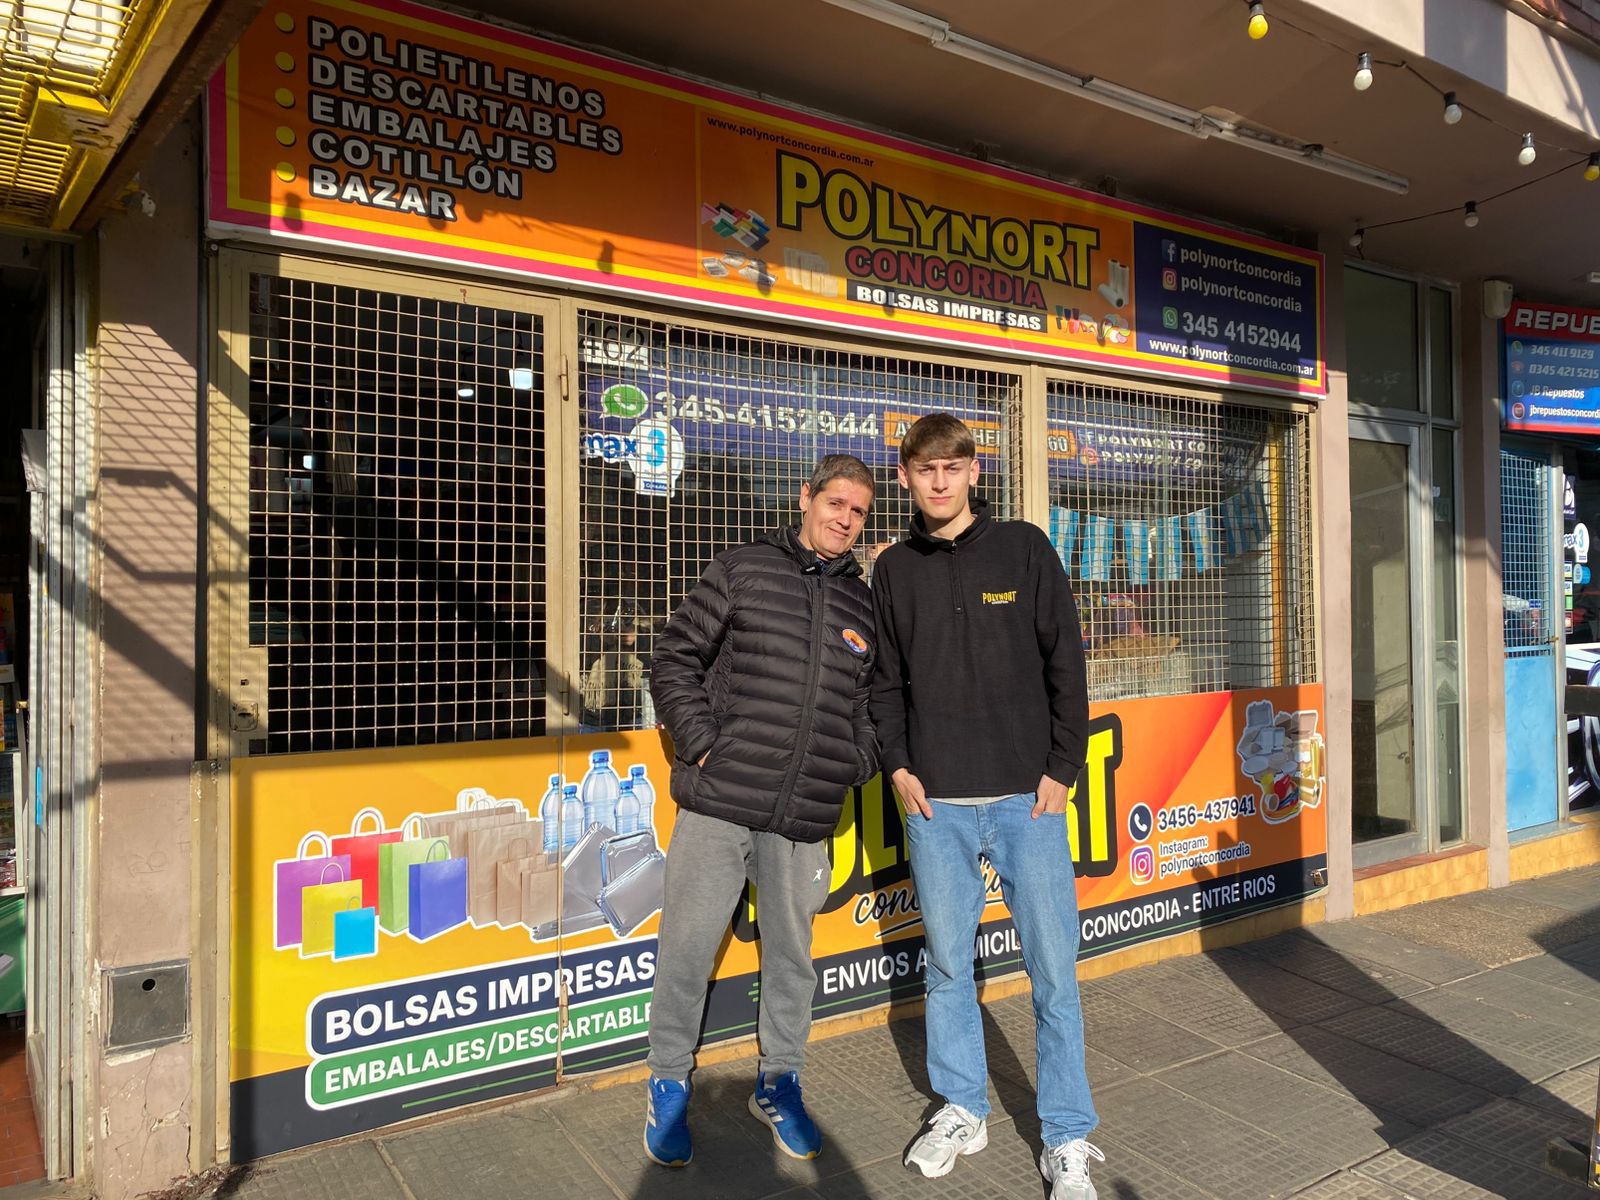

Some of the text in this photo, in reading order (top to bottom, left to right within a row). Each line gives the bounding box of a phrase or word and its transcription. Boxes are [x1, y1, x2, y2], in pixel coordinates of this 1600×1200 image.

[310, 19, 605, 118] POLIETILENOS
[310, 56, 622, 154] DESCARTABLES
[310, 95, 556, 172] EMBALAJES
[706, 116, 874, 168] www.polynortconcordia.com.ar
[310, 132, 522, 198] COTILLÓN
[311, 168, 457, 221] BAZAR
[776, 149, 1100, 291] POLYNORT
[845, 246, 1047, 311] CONCORDIA
[1180, 247, 1302, 287] polynortconcordia
[856, 285, 1042, 332] BOLSAS IMPRESAS
[1181, 276, 1302, 313] polynortconcordia
[1182, 311, 1301, 353] 345 4152944
[1530, 345, 1595, 359] 345 411 9129
[1149, 339, 1314, 376] www.polynortconcordia.com.ar
[1528, 364, 1599, 379] 0345 421 5215
[653, 391, 879, 439] 345-4152944
[1542, 385, 1584, 399] Repuestos
[982, 591, 1017, 605] POLYNORT
[1157, 796, 1256, 832] 3456-437941
[1159, 836, 1208, 856] Instagram:
[1160, 843, 1250, 878] polynortconcordia
[823, 951, 910, 996] ENVIOS
[1082, 898, 1181, 941] CONCORDIA
[1193, 882, 1240, 912] ENTRE
[1243, 874, 1276, 899] RIOS
[325, 951, 656, 1044] BOLSAS IMPRESAS
